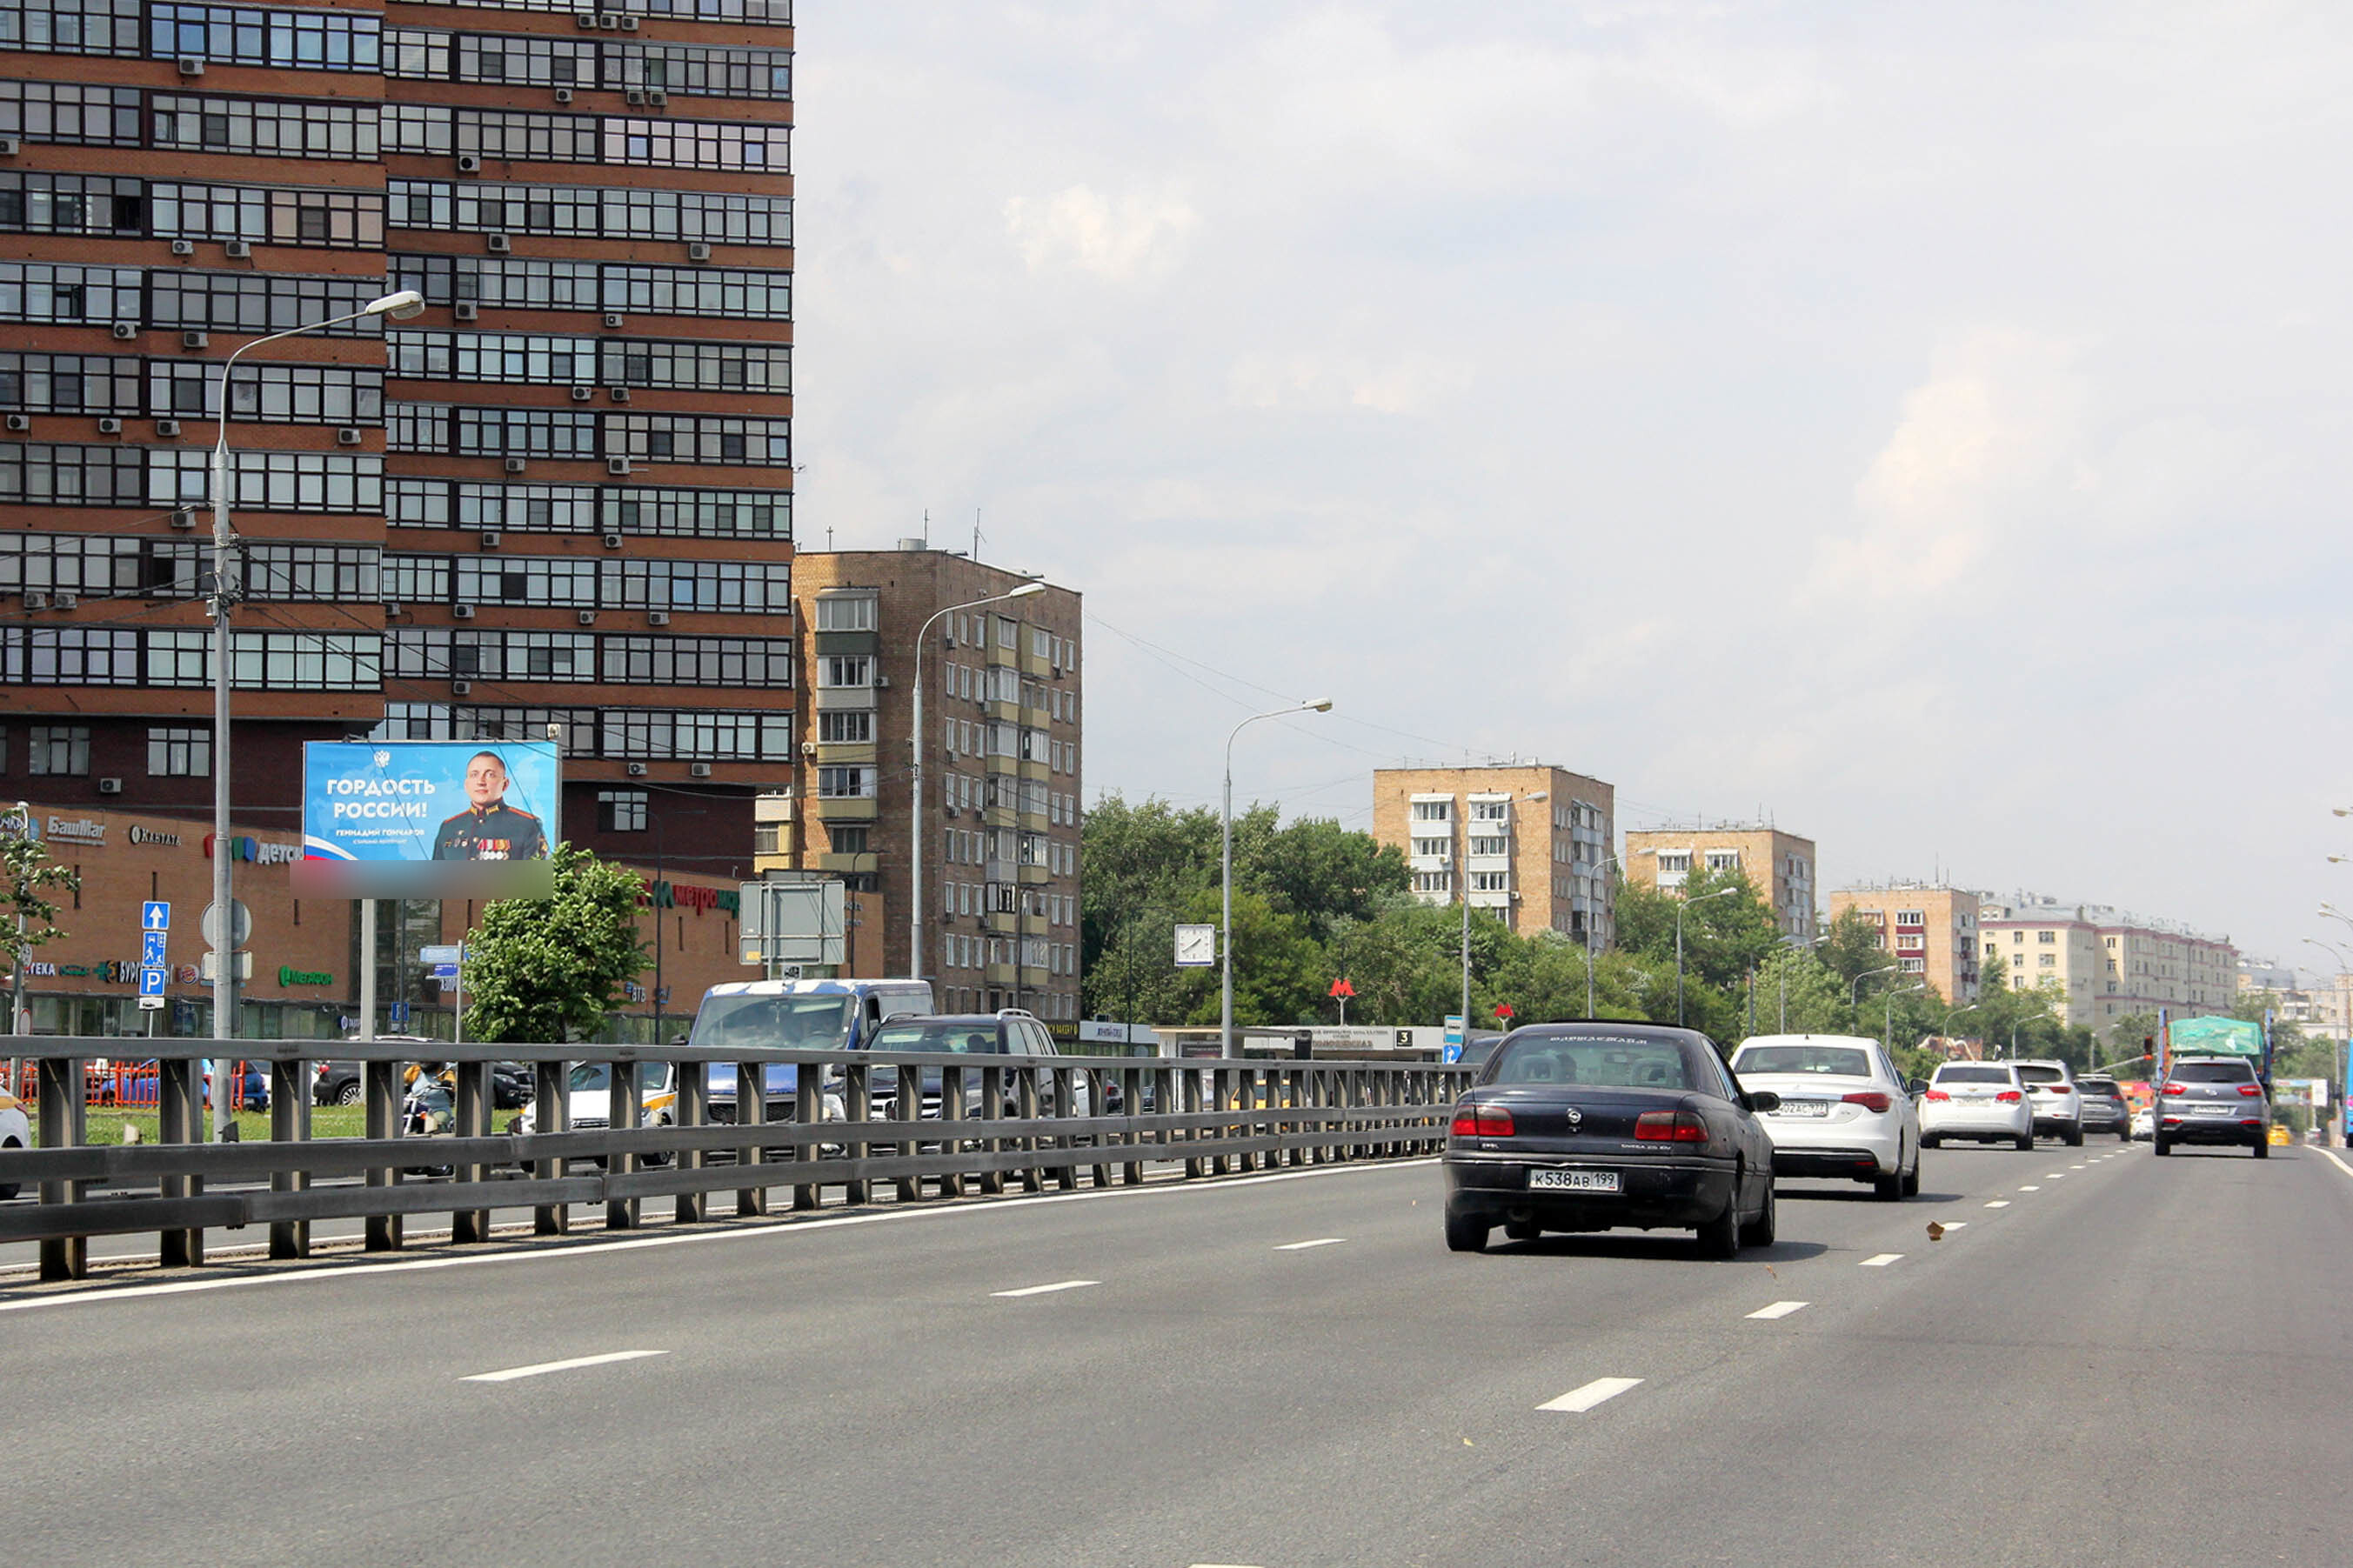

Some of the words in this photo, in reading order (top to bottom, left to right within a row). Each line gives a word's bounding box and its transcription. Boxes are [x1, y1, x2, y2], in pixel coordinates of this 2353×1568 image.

[327, 779, 436, 797] ГОРДОСТЬ
[334, 802, 427, 818] РОССИИ!
[48, 816, 105, 837] БашМаг
[673, 884, 739, 919] метромар
[146, 972, 161, 992] P
[291, 971, 334, 985] МЕГАФОН
[1400, 1031, 1408, 1043] 3
[1535, 1171, 1590, 1188] К538АВ
[1594, 1173, 1614, 1184] 199
